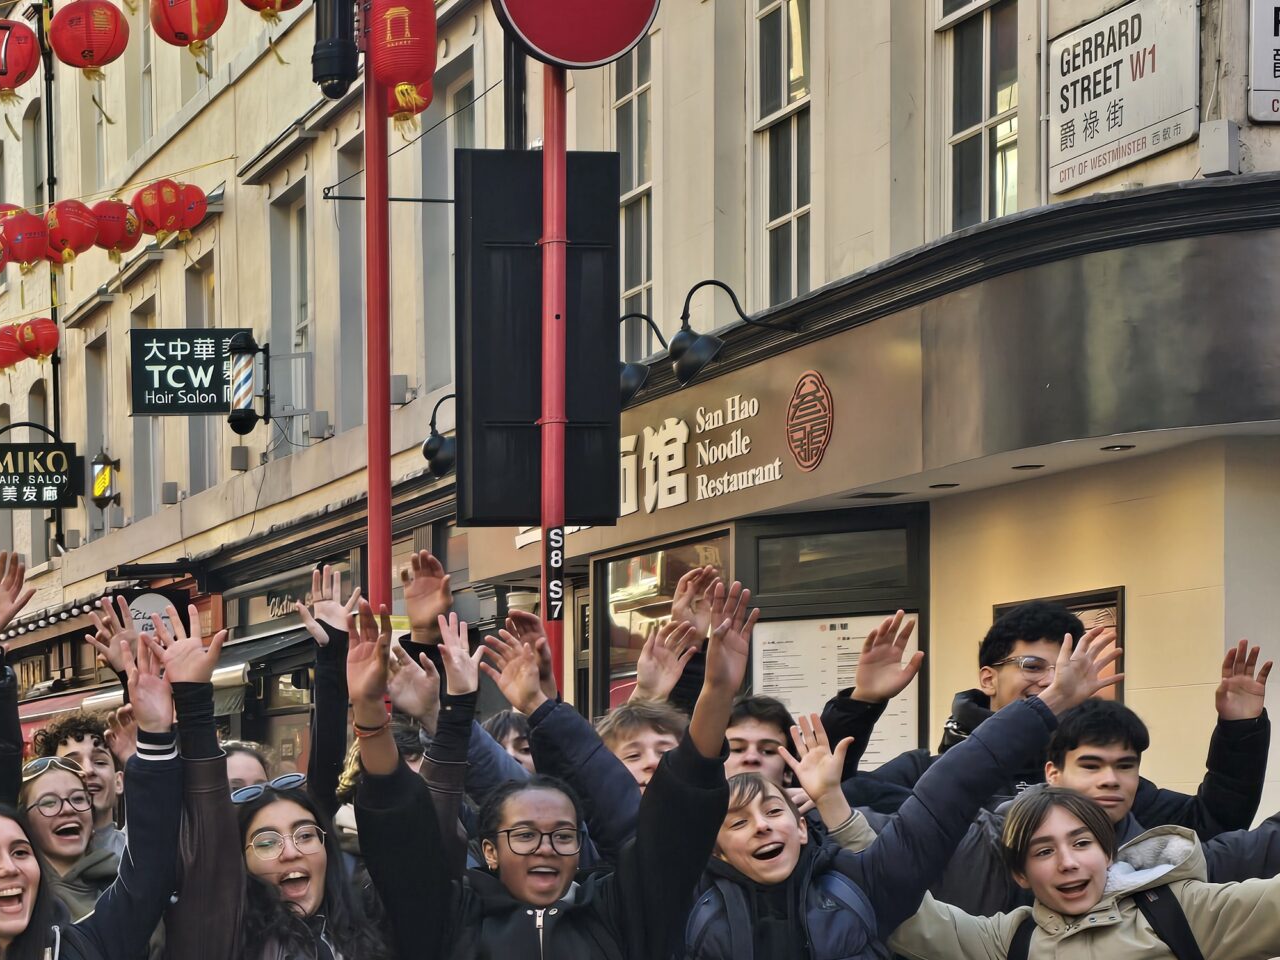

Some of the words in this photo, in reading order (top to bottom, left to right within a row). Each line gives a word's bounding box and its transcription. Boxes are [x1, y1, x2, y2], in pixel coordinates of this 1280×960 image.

[1060, 13, 1142, 77] GERRARD
[1060, 59, 1123, 114] STREET
[1130, 44, 1156, 81] W1
[1060, 97, 1124, 152] 爵祿街
[1059, 165, 1076, 183] CITY
[1078, 160, 1088, 176] OF
[1090, 136, 1147, 170] WESTMINSTER
[144, 338, 216, 361] 大中華
[145, 365, 214, 388] TCW
[145, 390, 174, 404] Hair
[178, 390, 217, 404] Salon
[695, 406, 724, 434] San
[725, 394, 759, 425] Hao
[696, 428, 751, 468] Noodle
[2, 486, 58, 502] 美发廊
[28, 475, 68, 484] SALON
[696, 457, 783, 501] Restaurant
[549, 528, 563, 568] S8
[549, 579, 563, 619] S7
